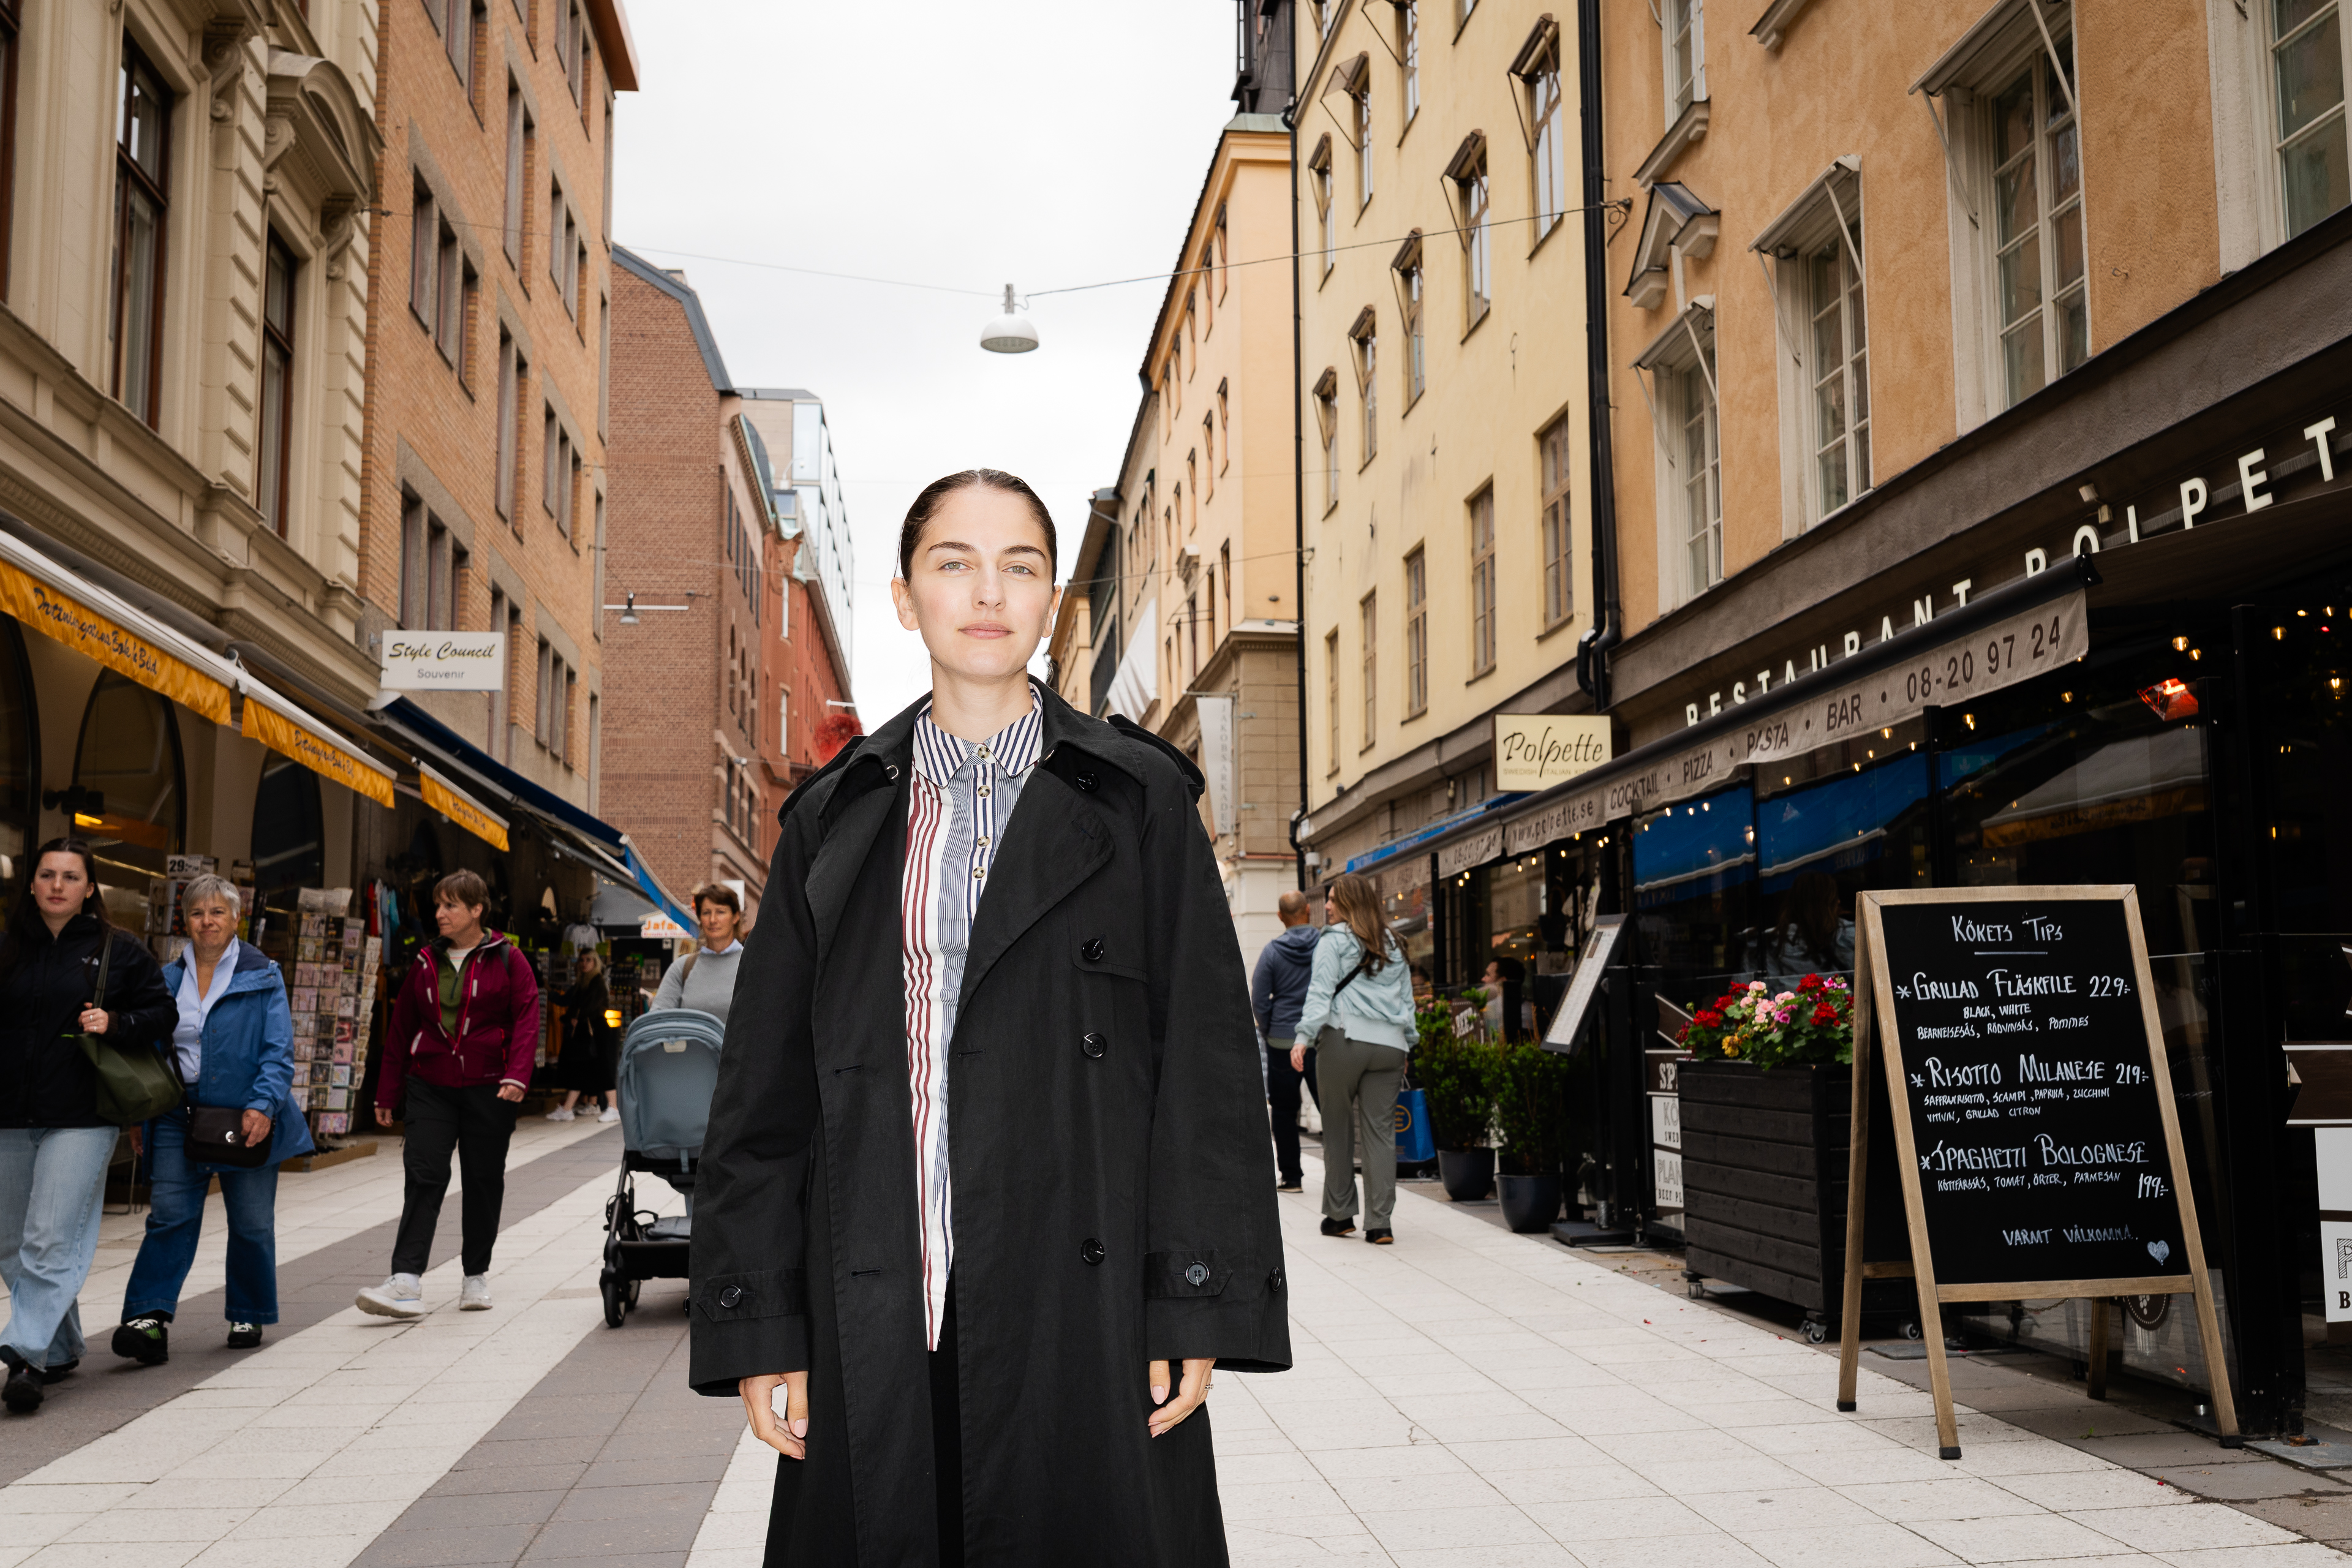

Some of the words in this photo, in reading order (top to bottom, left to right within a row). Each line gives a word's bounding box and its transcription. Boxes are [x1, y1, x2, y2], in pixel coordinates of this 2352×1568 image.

[388, 643, 432, 662] Style
[436, 641, 496, 661] Council
[417, 668, 466, 679] Souvenir
[1610, 773, 1659, 810] COCKTAIL
[1683, 750, 1713, 786] PIZZA
[1746, 722, 1789, 758] PASTA
[1826, 693, 1862, 731] BAR
[1907, 650, 1973, 703] 08-20
[1987, 633, 2015, 674] 97
[2030, 616, 2061, 659] 24
[1503, 726, 1604, 778] Polpette
[1951, 915, 2013, 942] KÖKETS
[2022, 916, 2063, 941] TIPS
[1913, 971, 1979, 1000] GRILLAD
[1986, 968, 2077, 998] FLÄSKFILE
[1962, 1006, 1996, 1020] BLACK,
[1999, 1003, 2032, 1016] WHITE
[2049, 1015, 2089, 1030] POMMES
[1925, 1056, 2002, 1088] RISOTTO
[2019, 1054, 2105, 1084] MILANESE
[2073, 1087, 2110, 1099] ZUCCHINI
[1965, 1107, 2000, 1119] GRILLAD
[2008, 1106, 2041, 1117] CITRON
[1931, 1140, 2027, 1171] SPAGHETTI
[2034, 1133, 2150, 1166] BOLOGNESE
[2073, 1171, 2121, 1184] PARMESAN
[2002, 1228, 2053, 1246] VARMT
